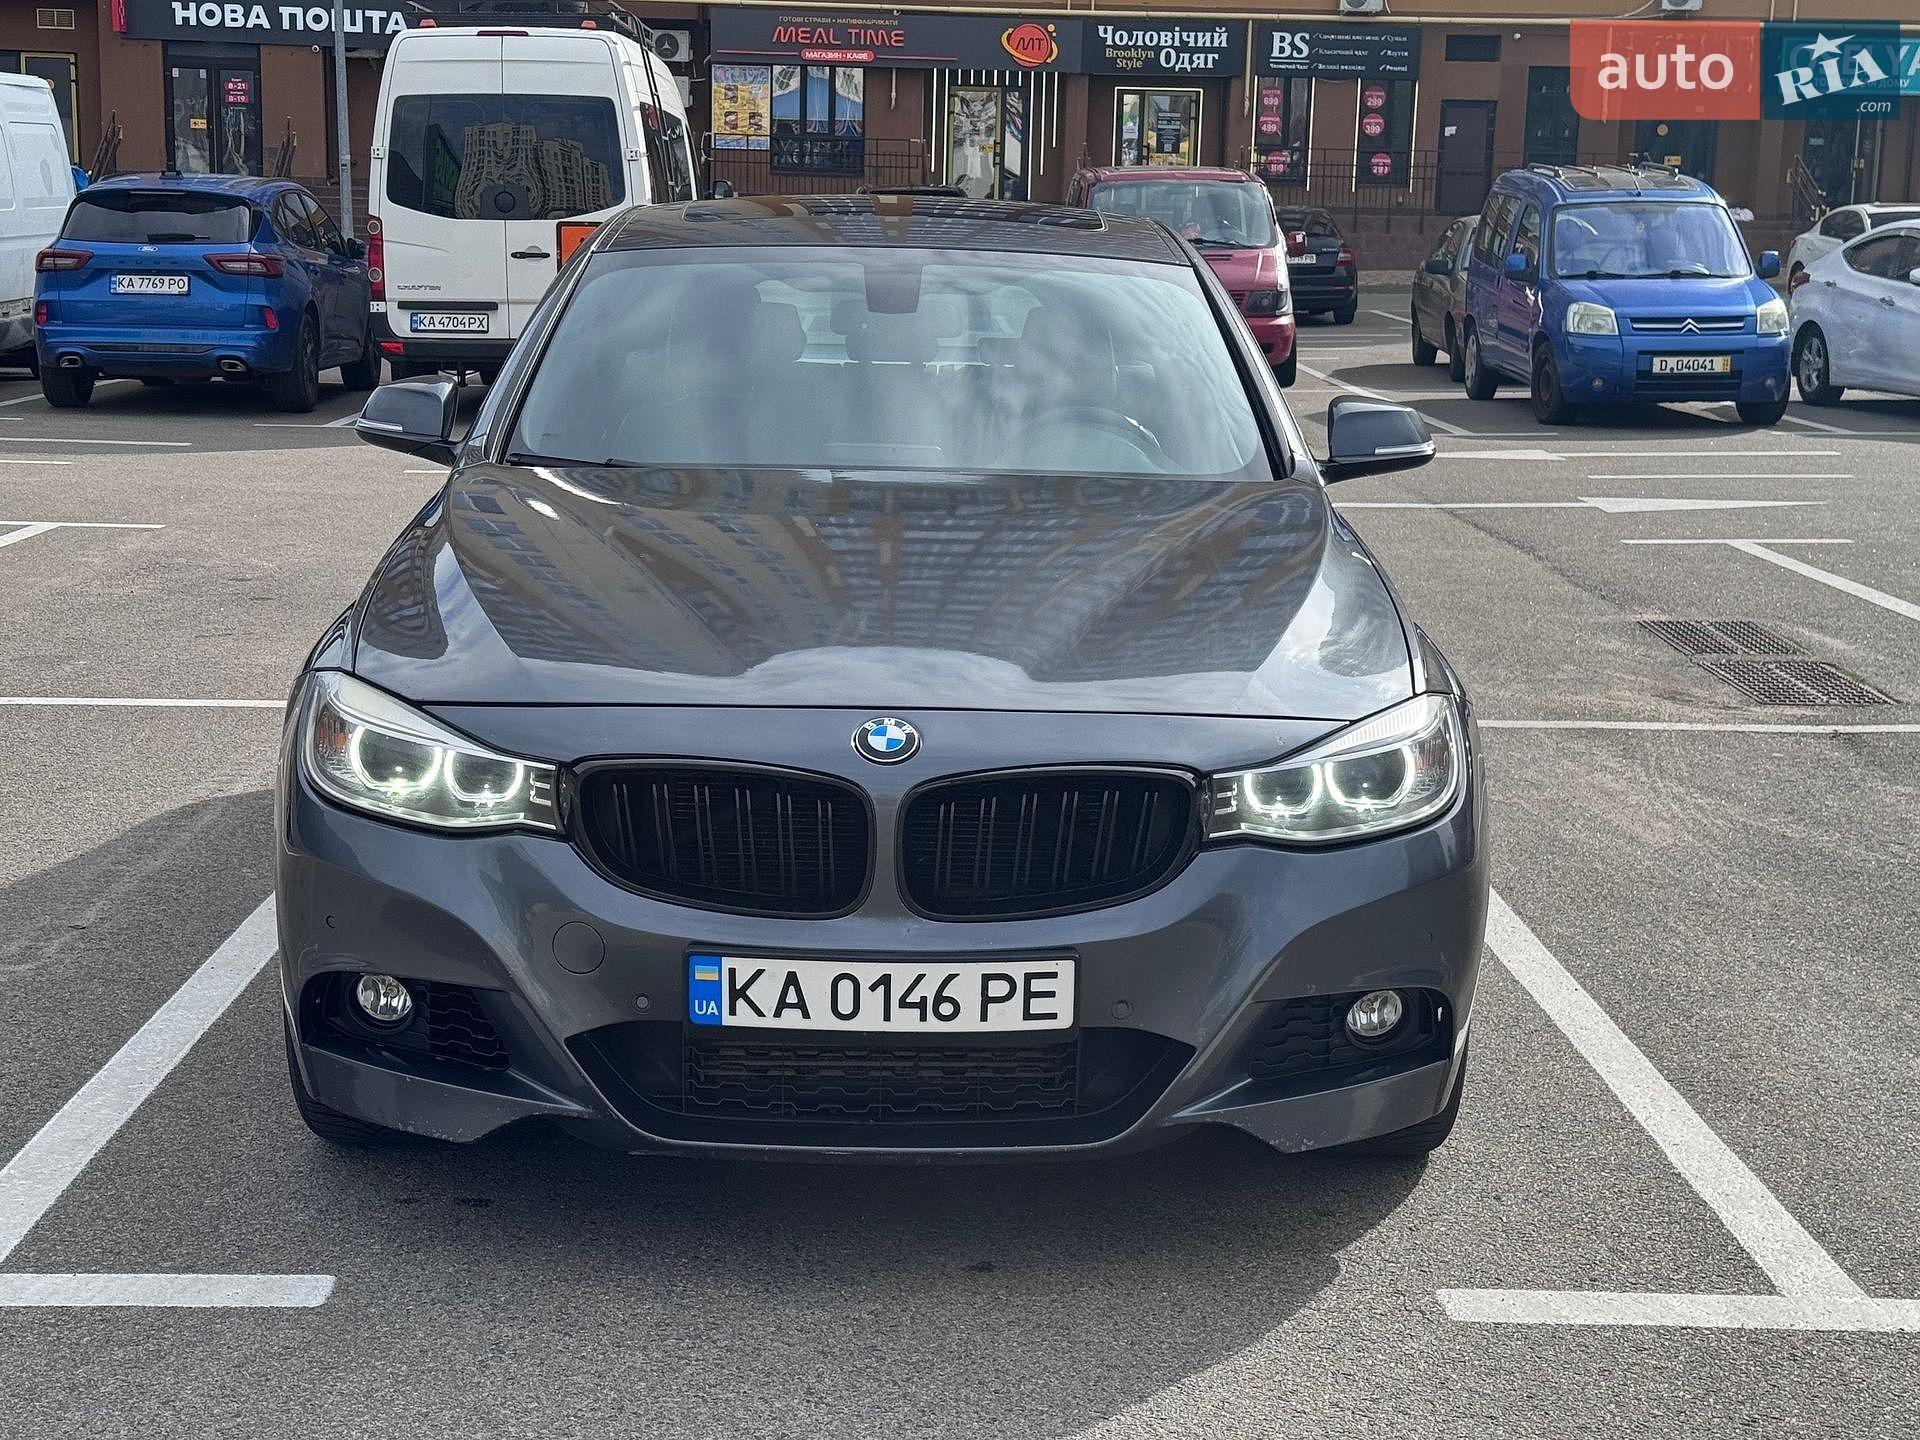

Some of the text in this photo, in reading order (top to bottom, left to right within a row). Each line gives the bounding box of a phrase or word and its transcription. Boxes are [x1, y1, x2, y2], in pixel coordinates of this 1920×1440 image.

[172, 1, 408, 35] НОВА ПОШТА
[772, 26, 905, 47] MEAL TIME
[1016, 37, 1044, 51] MT
[1098, 25, 1228, 47] Чоловічий
[1270, 31, 1310, 58] BS
[846, 52, 868, 60] КАФЕ
[1105, 48, 1155, 60] Brooklyn
[1159, 48, 1219, 72] Одяг
[1116, 58, 1143, 70] Style
[117, 277, 186, 289] KA 7769 PO
[418, 316, 486, 329] KA 4704 PX
[864, 718, 914, 734] BMW
[728, 967, 1059, 1022] KA 0146 PE
[695, 1000, 720, 1016] UA
